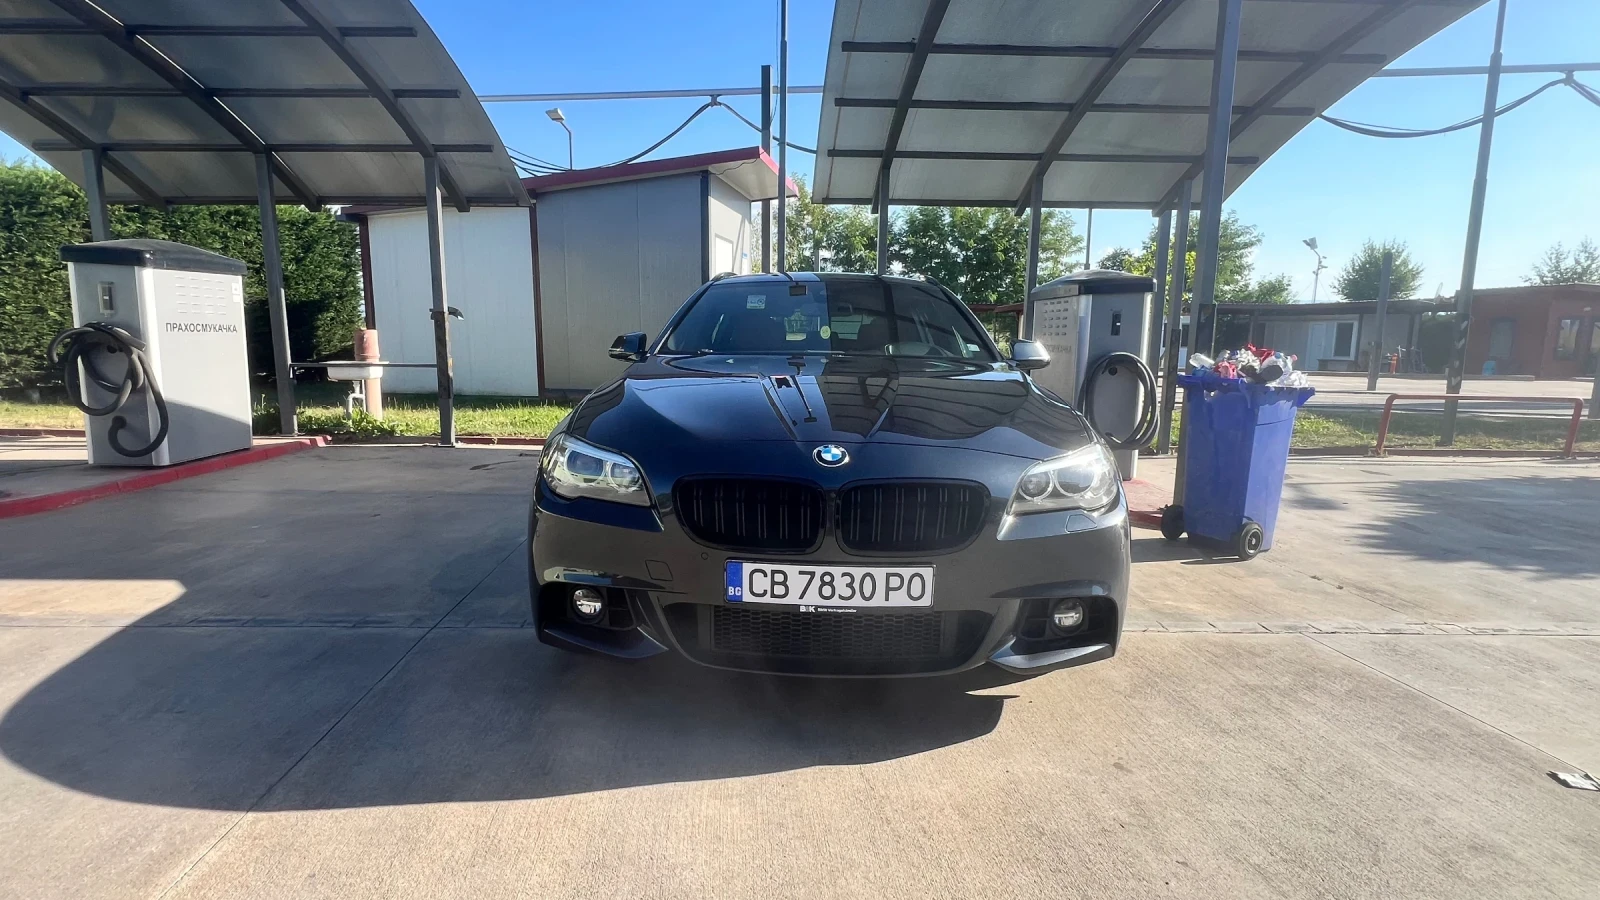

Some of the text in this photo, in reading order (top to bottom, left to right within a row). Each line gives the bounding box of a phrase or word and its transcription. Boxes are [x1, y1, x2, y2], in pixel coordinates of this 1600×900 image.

[165, 322, 238, 333] ПРАХОСМУКАЧКА
[748, 568, 790, 599] CB
[798, 570, 877, 602] 7830
[728, 587, 742, 596] BG
